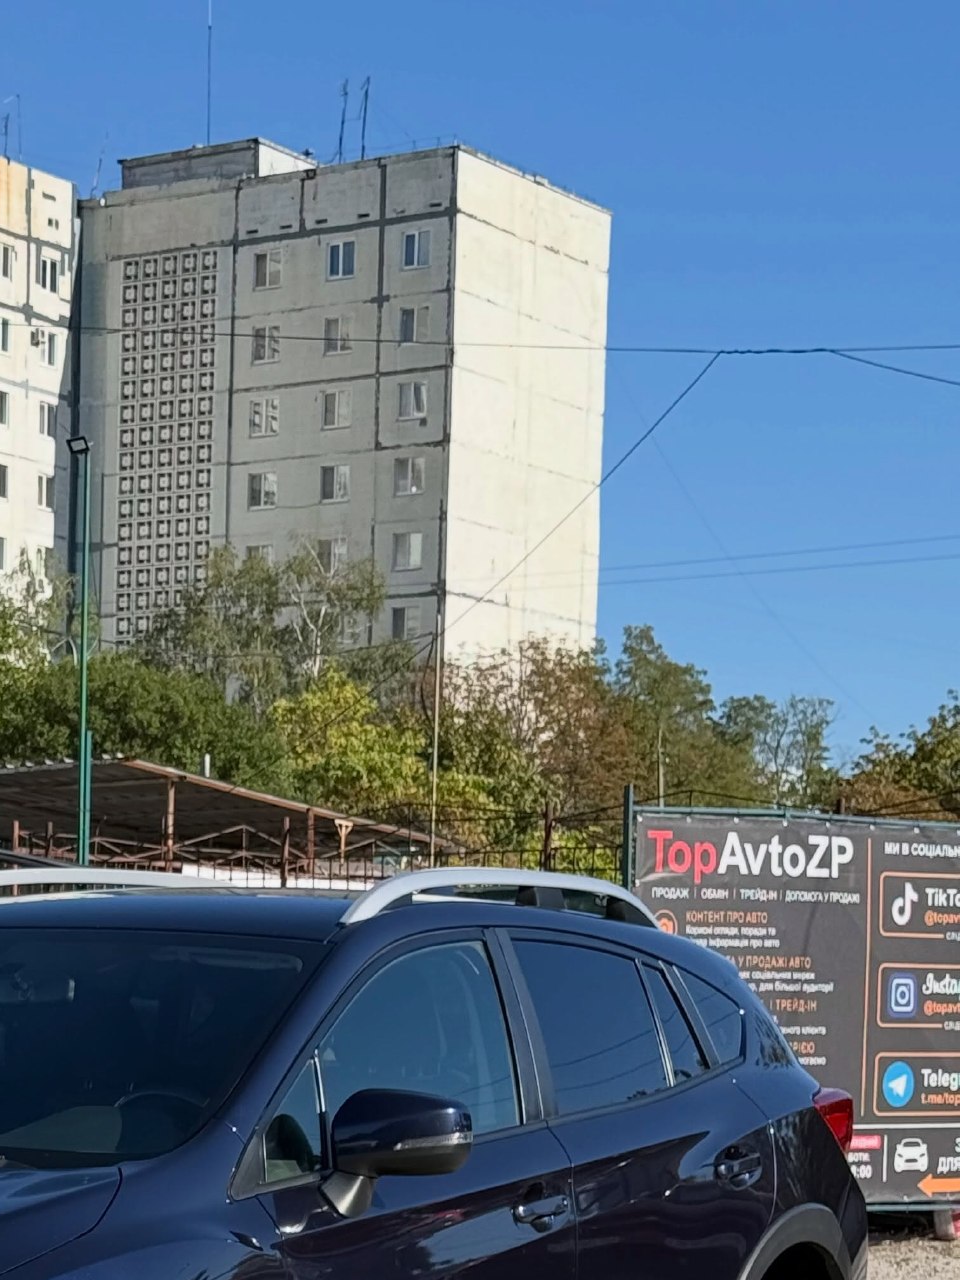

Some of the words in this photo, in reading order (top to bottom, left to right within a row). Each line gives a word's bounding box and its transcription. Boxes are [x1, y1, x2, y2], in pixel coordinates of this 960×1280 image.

[884, 842, 900, 855] МИ
[647, 830, 854, 884] TopAvtoZP
[651, 886, 690, 900] ПРОДАЖ
[726, 911, 744, 924] ПРО
